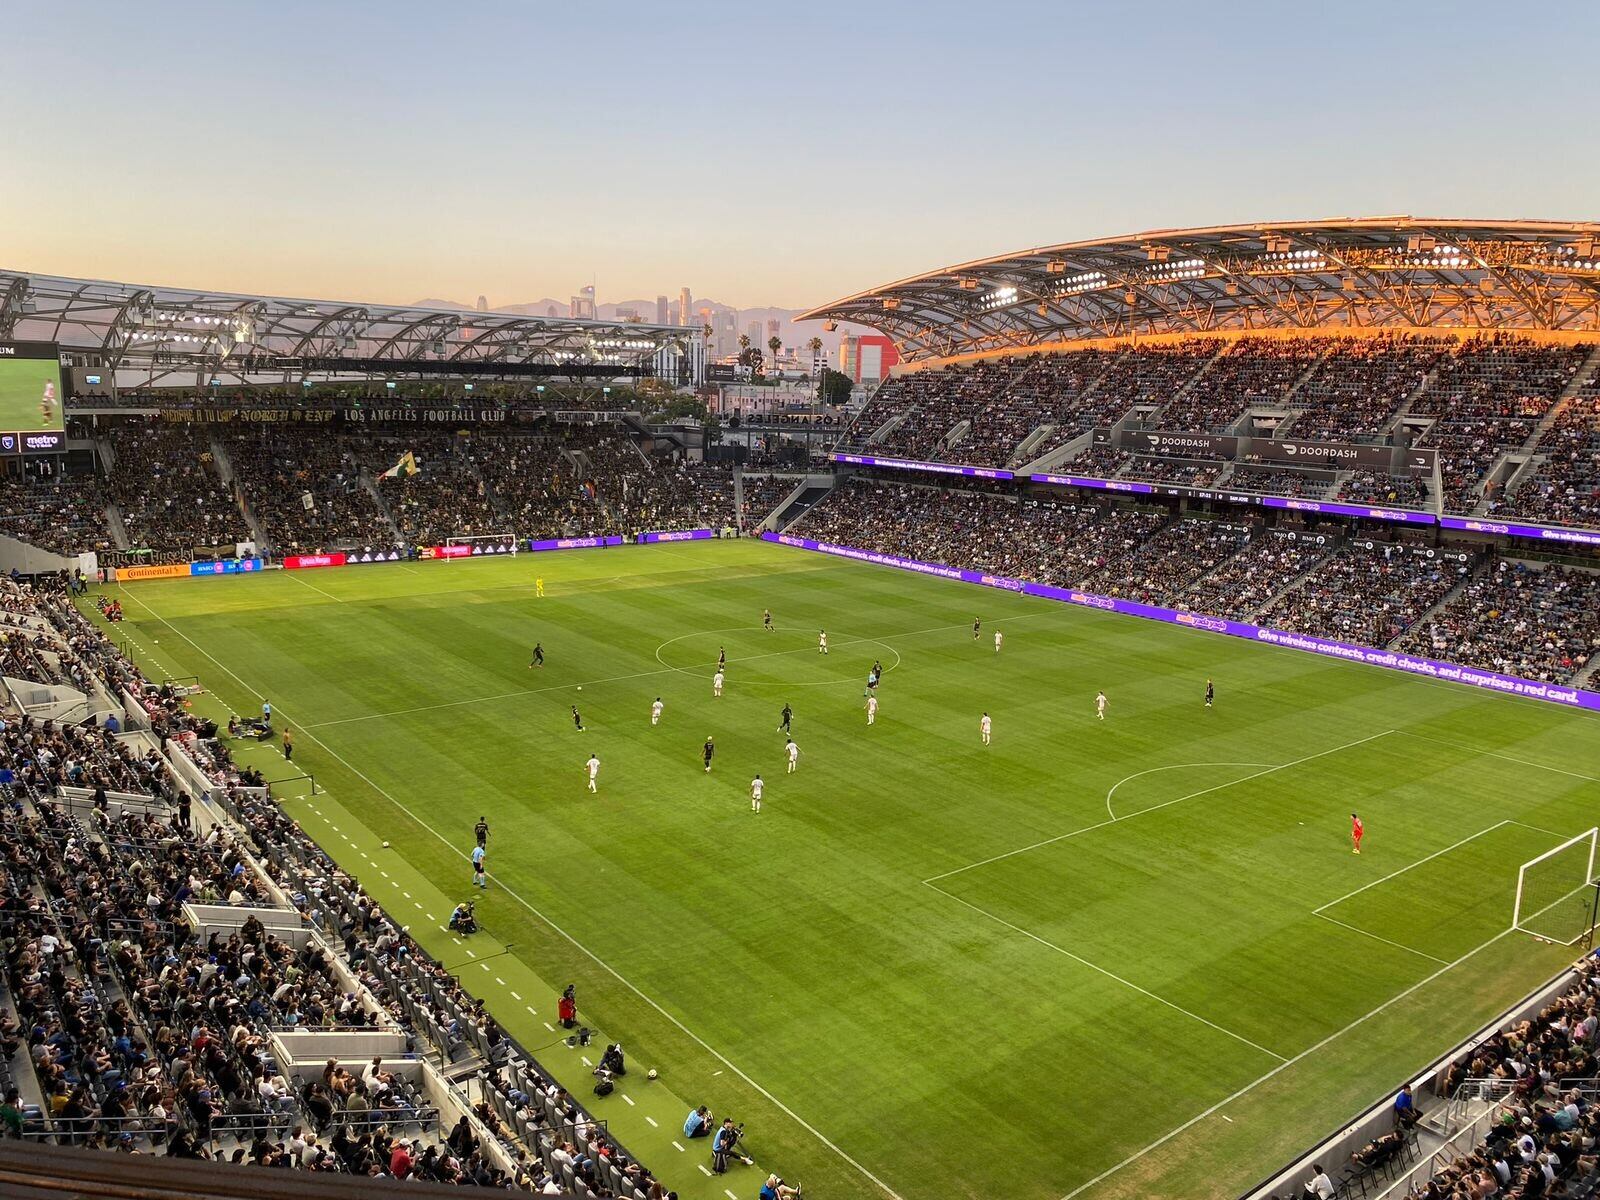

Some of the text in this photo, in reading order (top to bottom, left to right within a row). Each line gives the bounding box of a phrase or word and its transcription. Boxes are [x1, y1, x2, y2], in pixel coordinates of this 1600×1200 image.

[344, 409, 506, 422] LOS ANGELES FOOTBALL CLUB
[27, 435, 58, 445] metro
[1161, 437, 1210, 448] DOORDASH
[1299, 446, 1358, 459] DOORDASH
[1542, 530, 1560, 539] Give
[128, 567, 172, 578] Continental
[1257, 629, 1580, 704] Give wireless contracts, credit checks, and surprises a red card.
